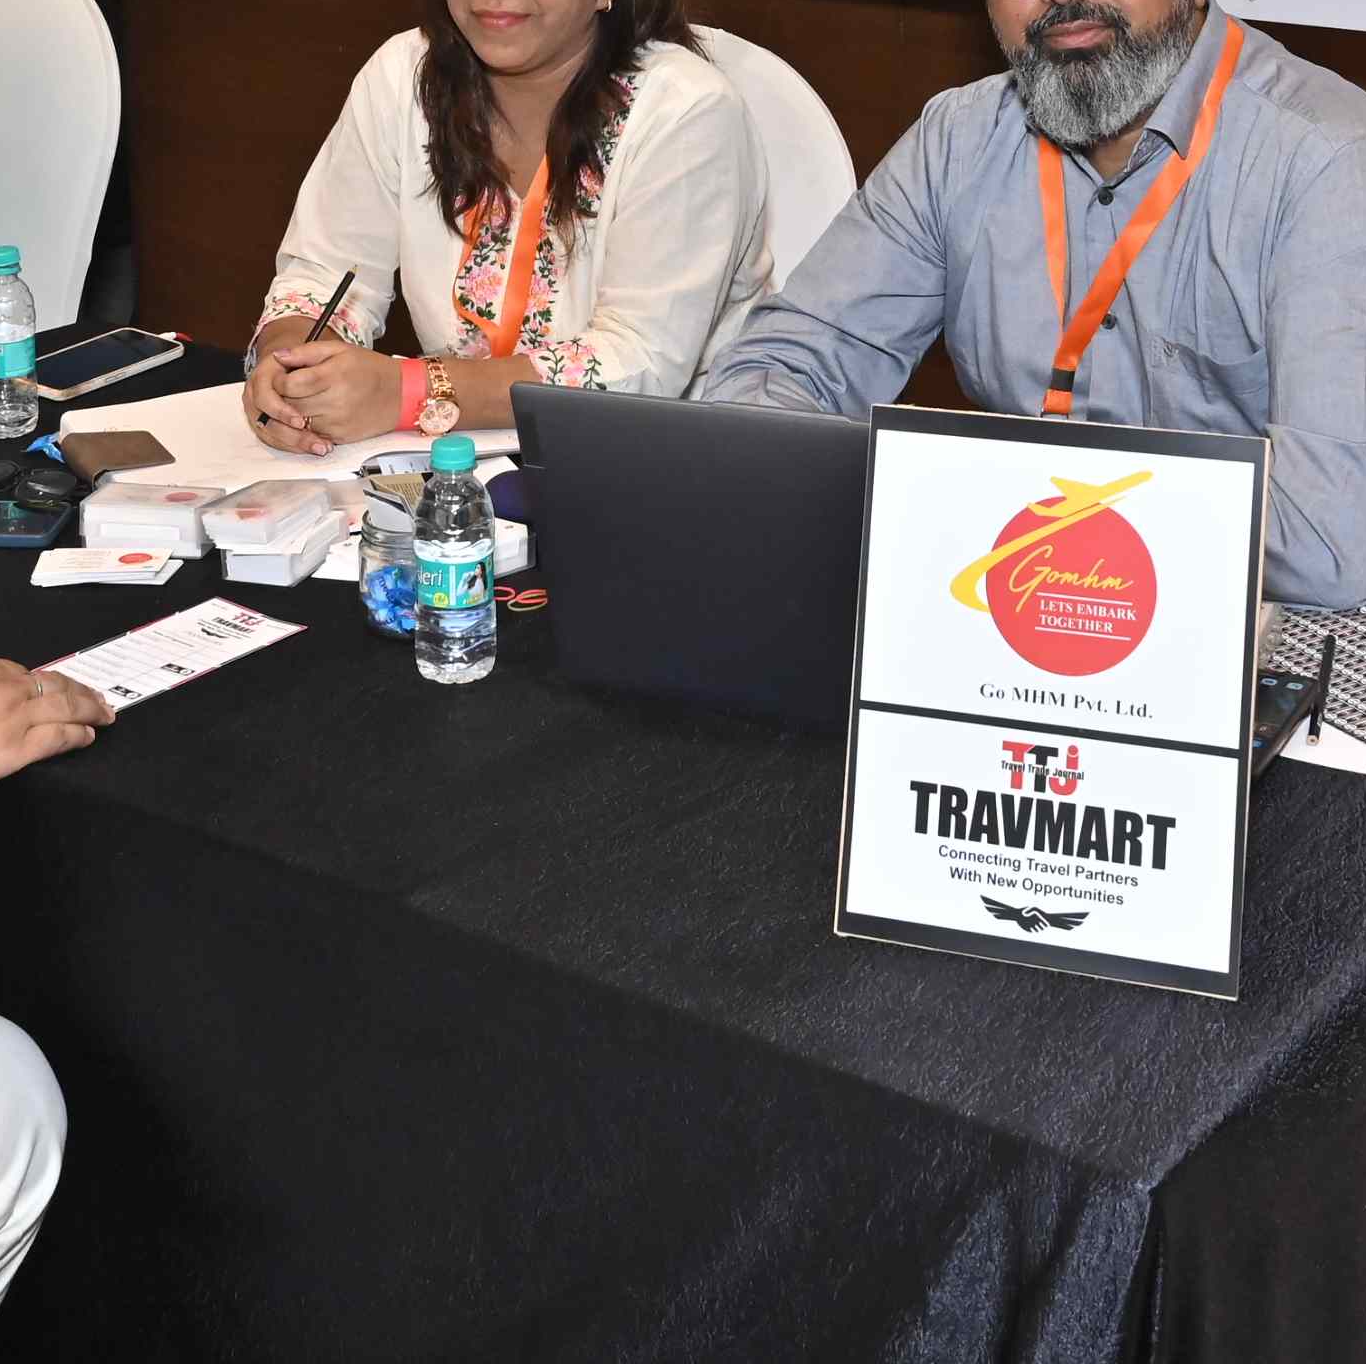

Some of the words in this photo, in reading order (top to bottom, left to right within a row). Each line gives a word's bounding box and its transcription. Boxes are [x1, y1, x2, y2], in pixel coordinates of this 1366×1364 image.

[1009, 545, 1134, 613] Gomhm
[1039, 615, 1113, 634] TOGETHER
[1040, 599, 1073, 615] LETS
[1076, 603, 1136, 621] EMBARK
[980, 683, 1005, 701] Go
[1011, 686, 1066, 708] MHM
[1074, 694, 1108, 713] Pvt.
[1116, 700, 1153, 719] Ltd.
[910, 780, 1176, 870] TRAVMART
[938, 844, 1021, 871] Connecting
[1026, 858, 1071, 876] Travel
[1075, 865, 1139, 887] Partners
[950, 867, 982, 884] With
[986, 873, 1017, 889] New
[1022, 878, 1124, 905] Opportunities
